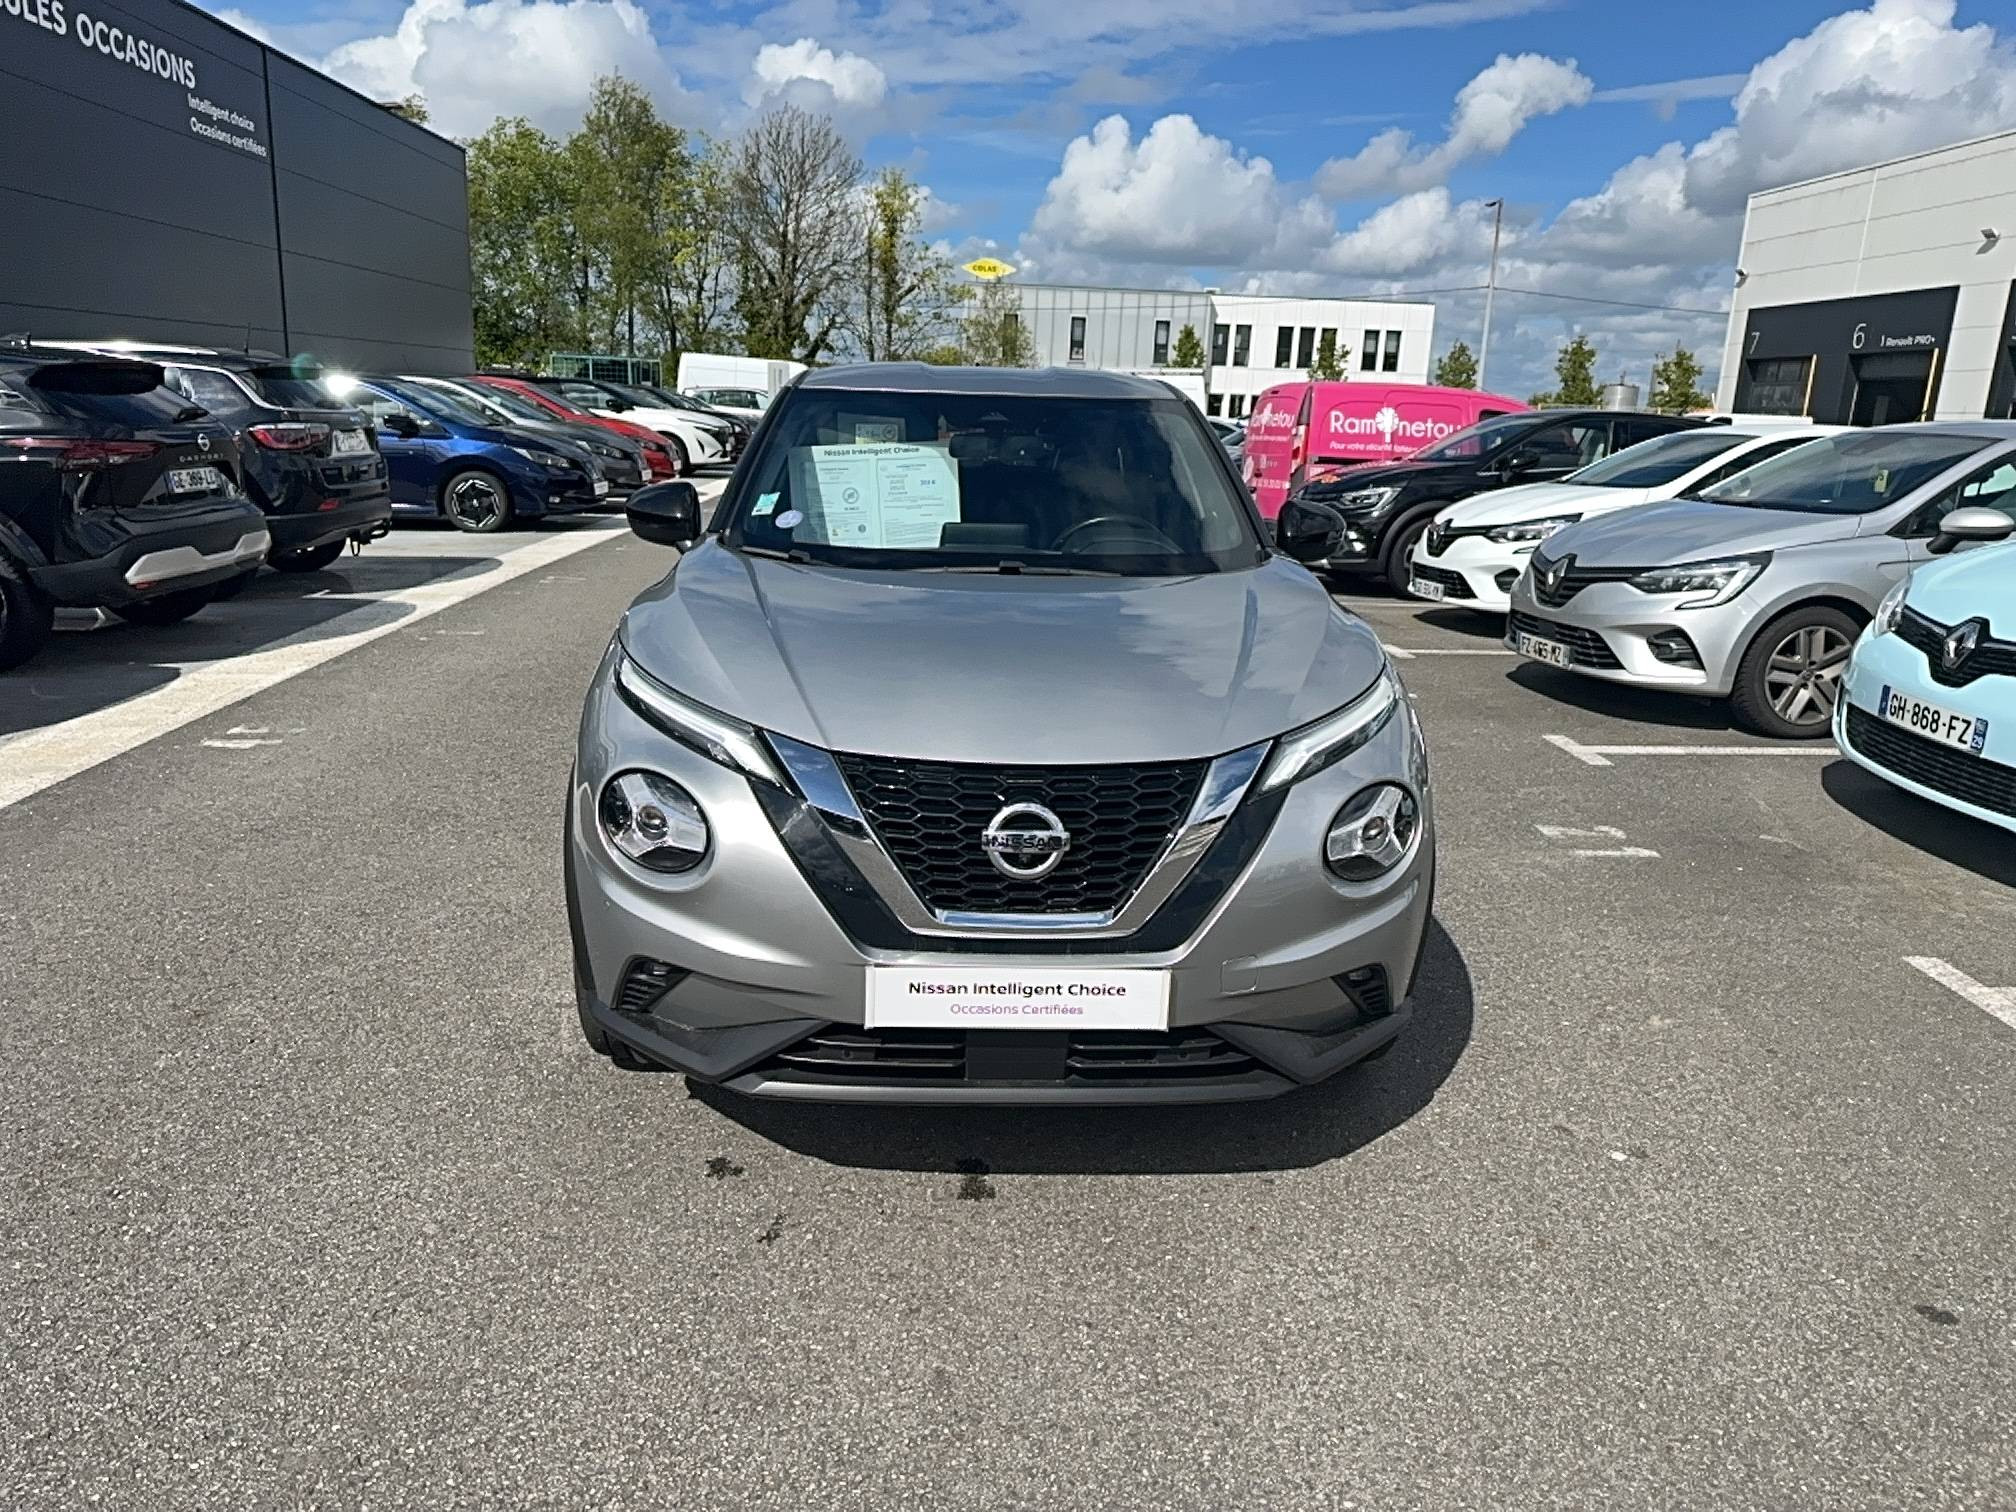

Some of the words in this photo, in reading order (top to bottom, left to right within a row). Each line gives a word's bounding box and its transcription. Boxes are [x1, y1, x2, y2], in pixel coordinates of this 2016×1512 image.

[0, 0, 67, 35] LES
[76, 13, 196, 89] OCCASIONS
[1750, 332, 1760, 354] 7
[1852, 323, 1867, 349] 6
[1889, 693, 1972, 745] GH-868-FZ
[908, 982, 968, 995] Nissan
[973, 982, 1064, 998] Intelligent
[1067, 983, 1127, 997] Choice
[949, 1003, 1019, 1015] Occasions
[1022, 1004, 1084, 1016] Certifiées
